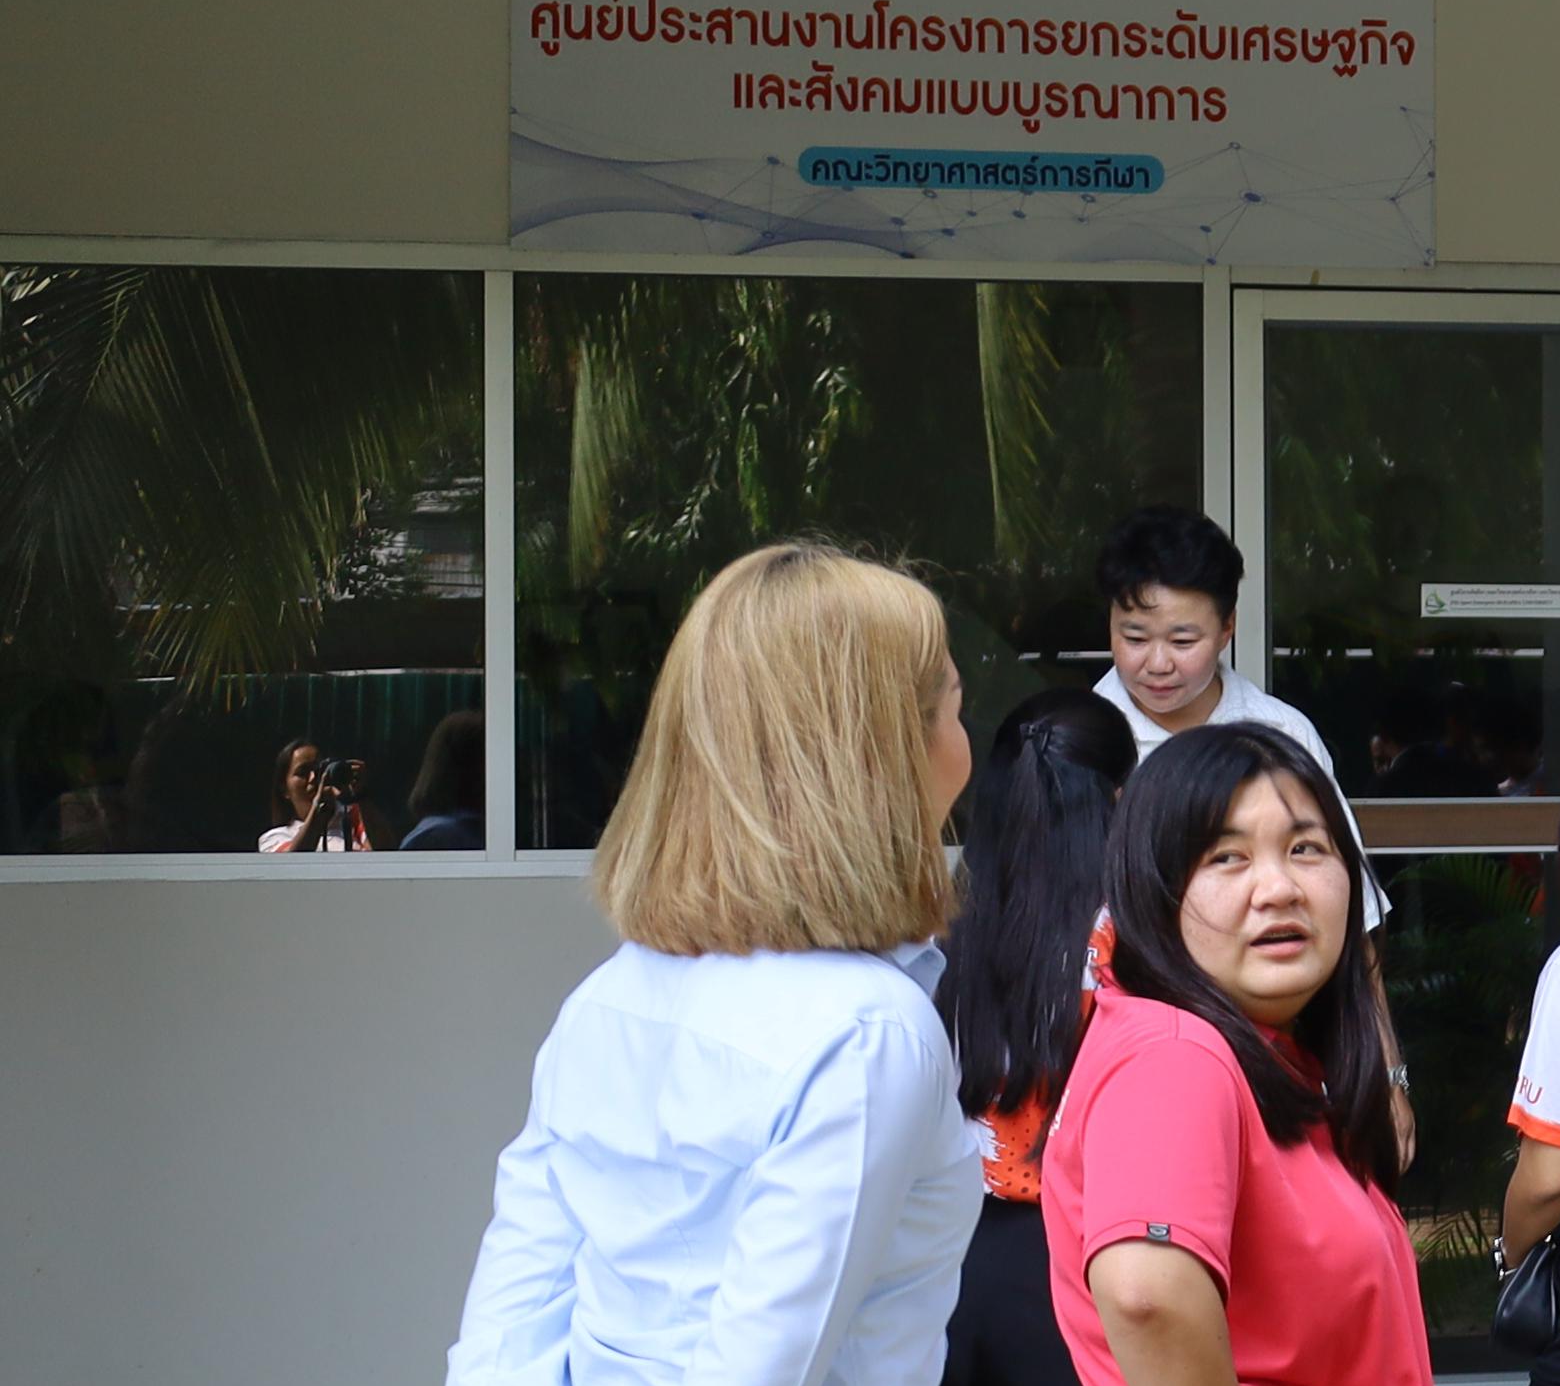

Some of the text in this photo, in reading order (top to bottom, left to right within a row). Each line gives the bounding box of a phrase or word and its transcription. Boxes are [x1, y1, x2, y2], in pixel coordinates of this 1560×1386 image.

[732, 61, 1228, 133] และสังคมแบบบูรณาการ
[811, 156, 1152, 193] คณะวิทยาศาสตร์การกีฬา
